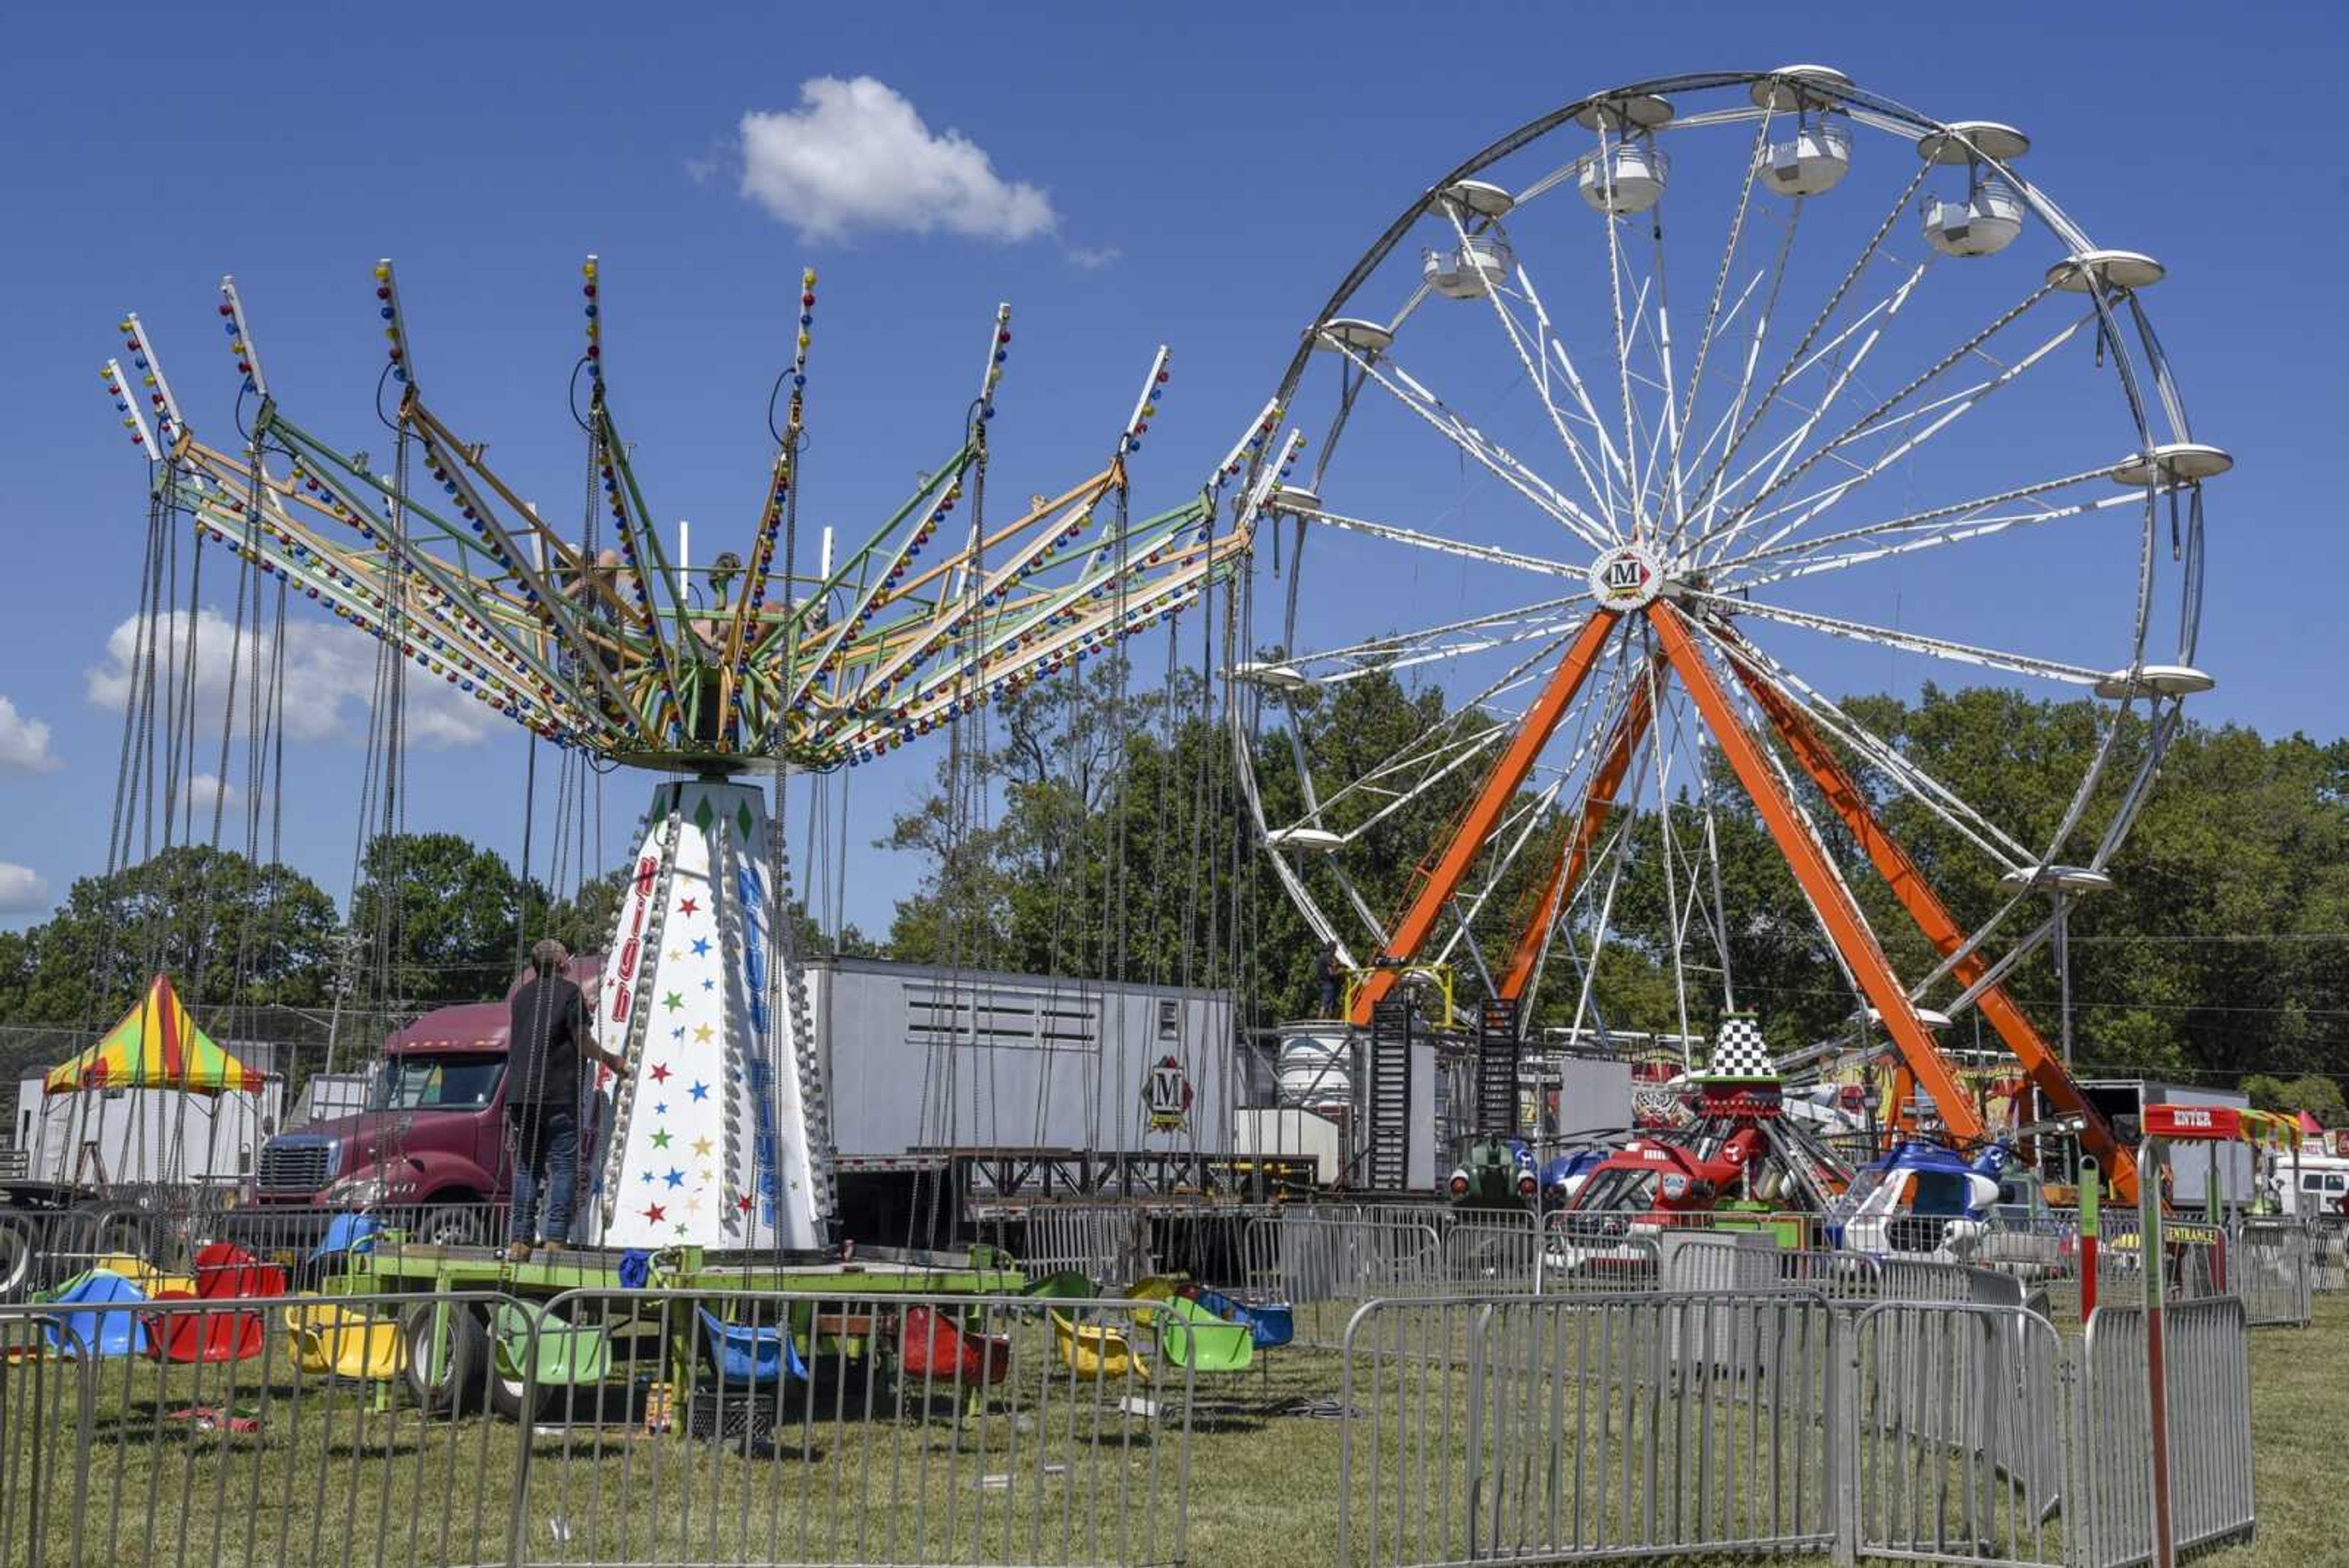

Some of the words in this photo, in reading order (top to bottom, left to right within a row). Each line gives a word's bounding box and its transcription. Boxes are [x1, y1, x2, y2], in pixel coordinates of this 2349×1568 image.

[1612, 562, 1638, 584] M
[612, 856, 658, 1022] High
[1155, 1072, 1182, 1107] M
[2173, 1110, 2212, 1128] ENTER
[2169, 1227, 2216, 1244] ENTRANCE
